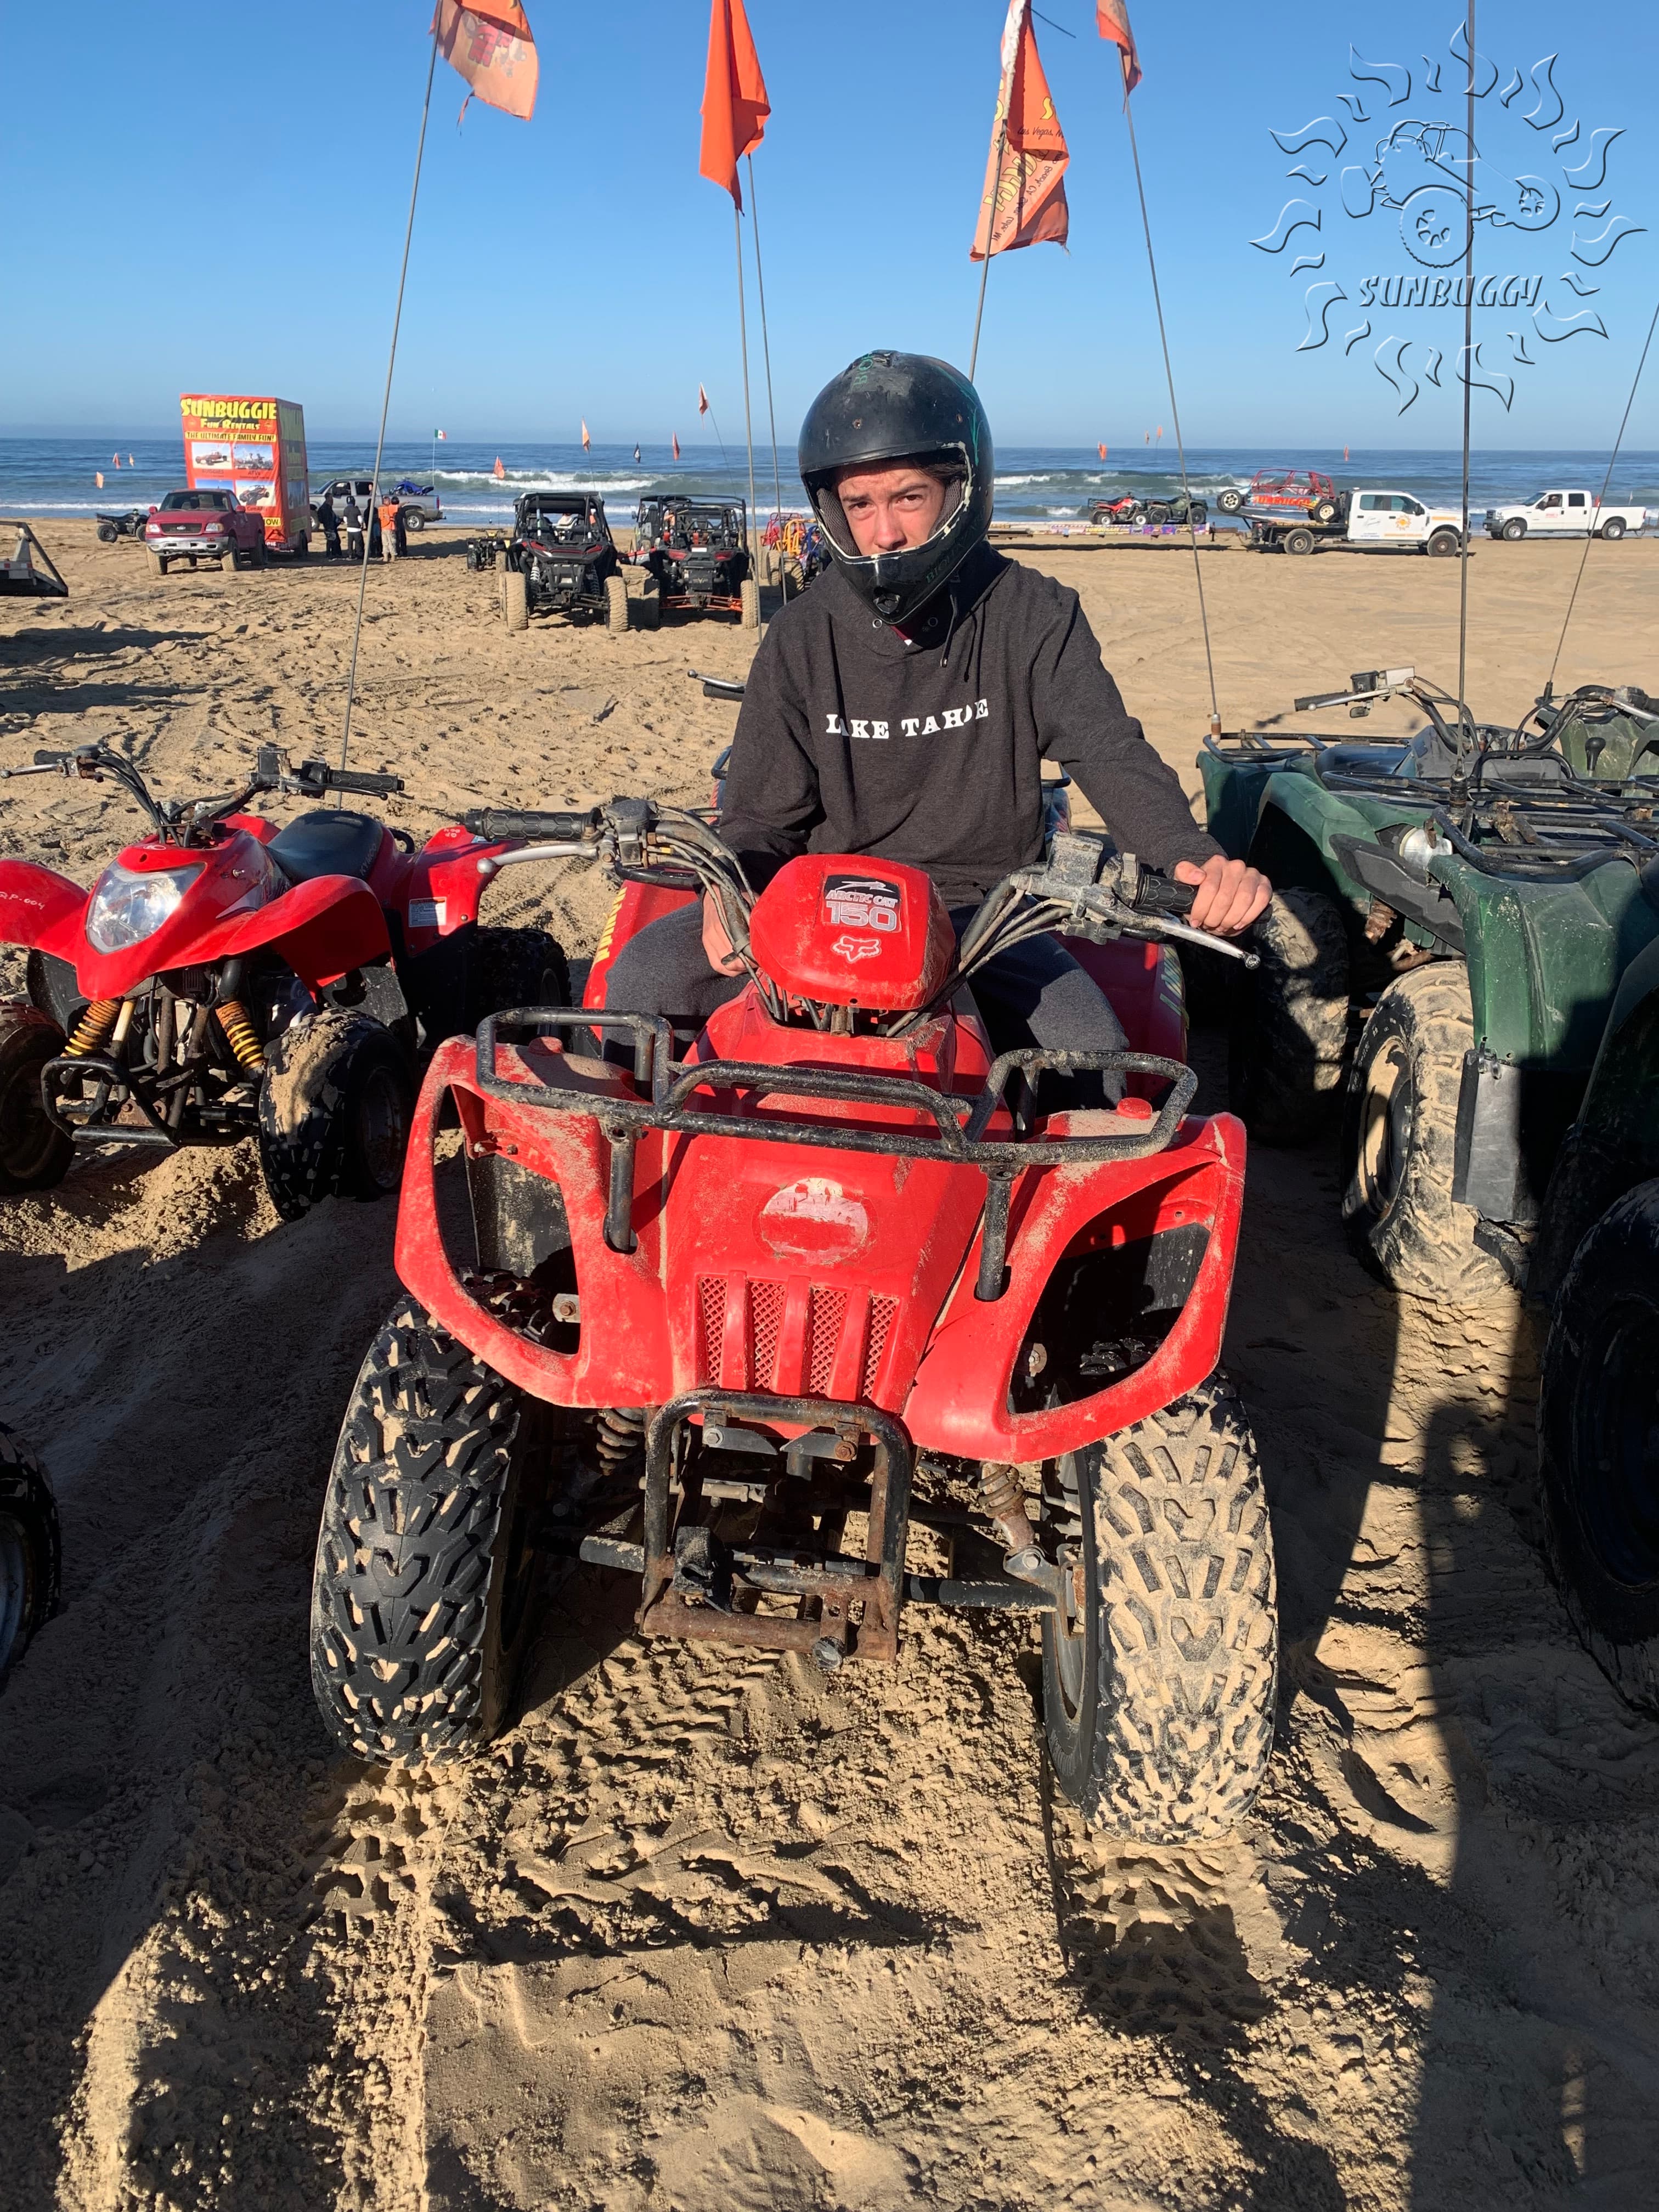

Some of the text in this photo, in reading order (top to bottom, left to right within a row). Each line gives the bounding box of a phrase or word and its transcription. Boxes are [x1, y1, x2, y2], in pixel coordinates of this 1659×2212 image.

[180, 398, 277, 420] SUNBUGGIE
[825, 890, 898, 909] ARCTIC CAT
[826, 900, 897, 931] 150
